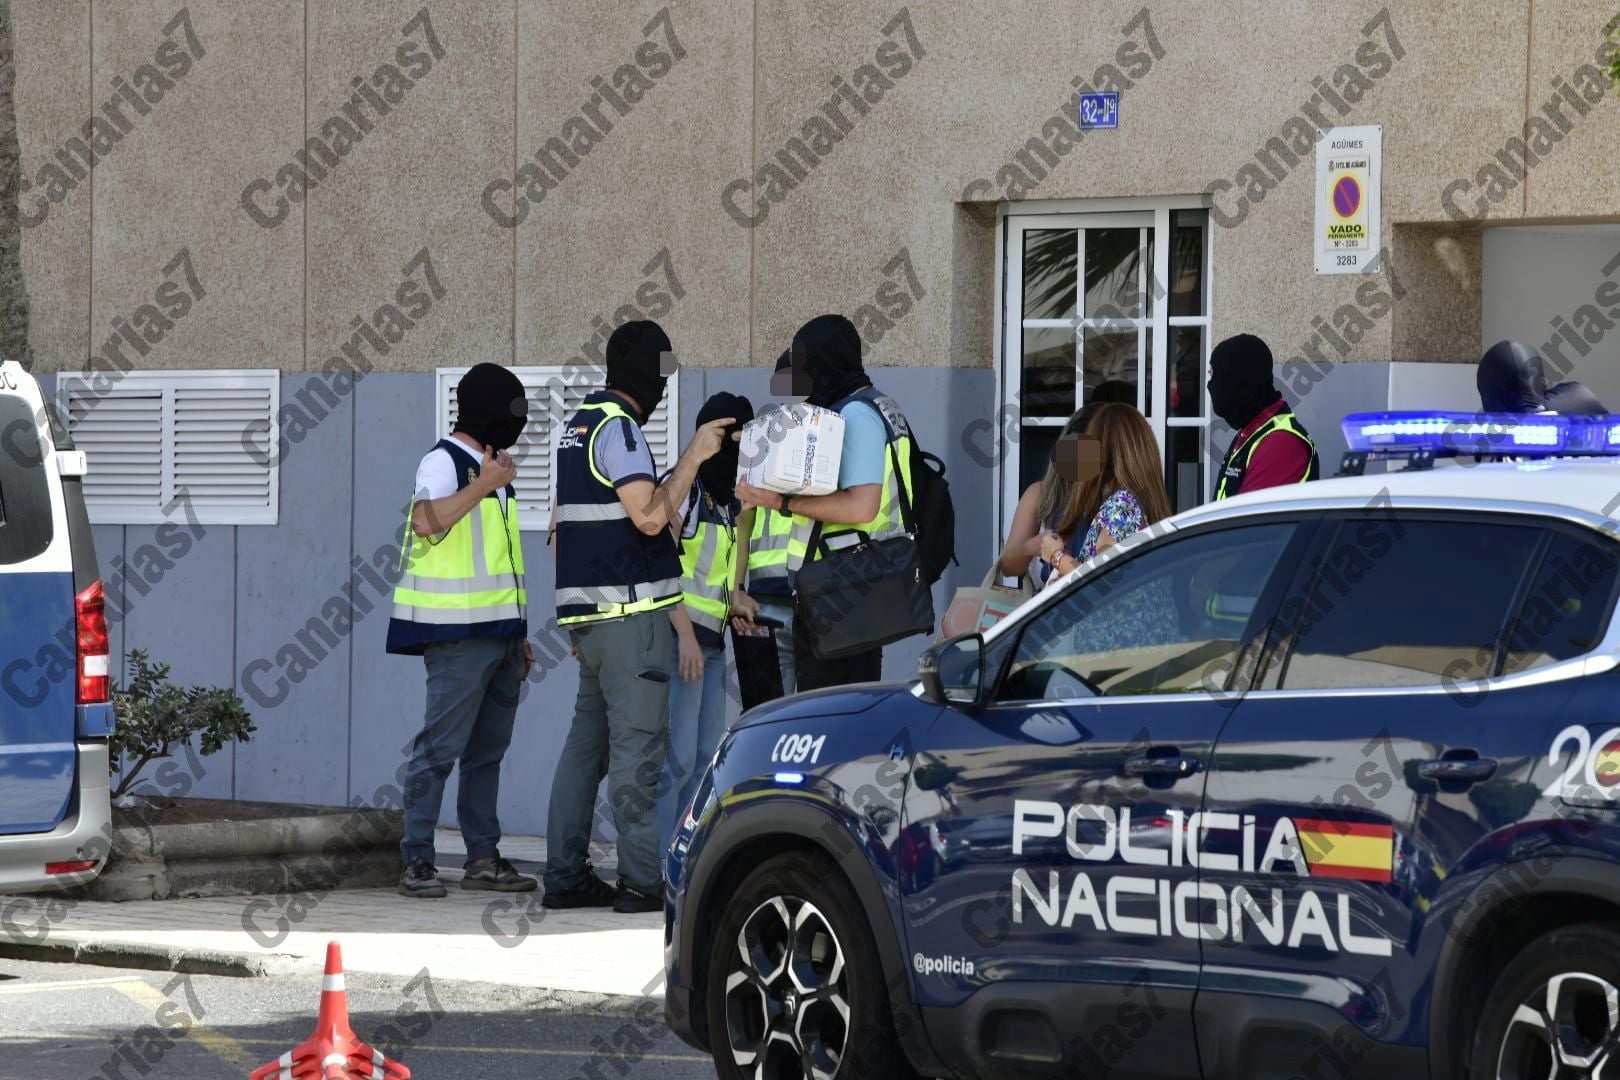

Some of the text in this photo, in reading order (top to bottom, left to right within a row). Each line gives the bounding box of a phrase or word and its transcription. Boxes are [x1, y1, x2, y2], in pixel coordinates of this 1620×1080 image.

[1330, 224, 1361, 233] VADO
[1336, 255, 1357, 265] 3283
[780, 734, 826, 764] 091
[1012, 868, 1392, 956] NACIONAL
[914, 952, 974, 976] @policia
